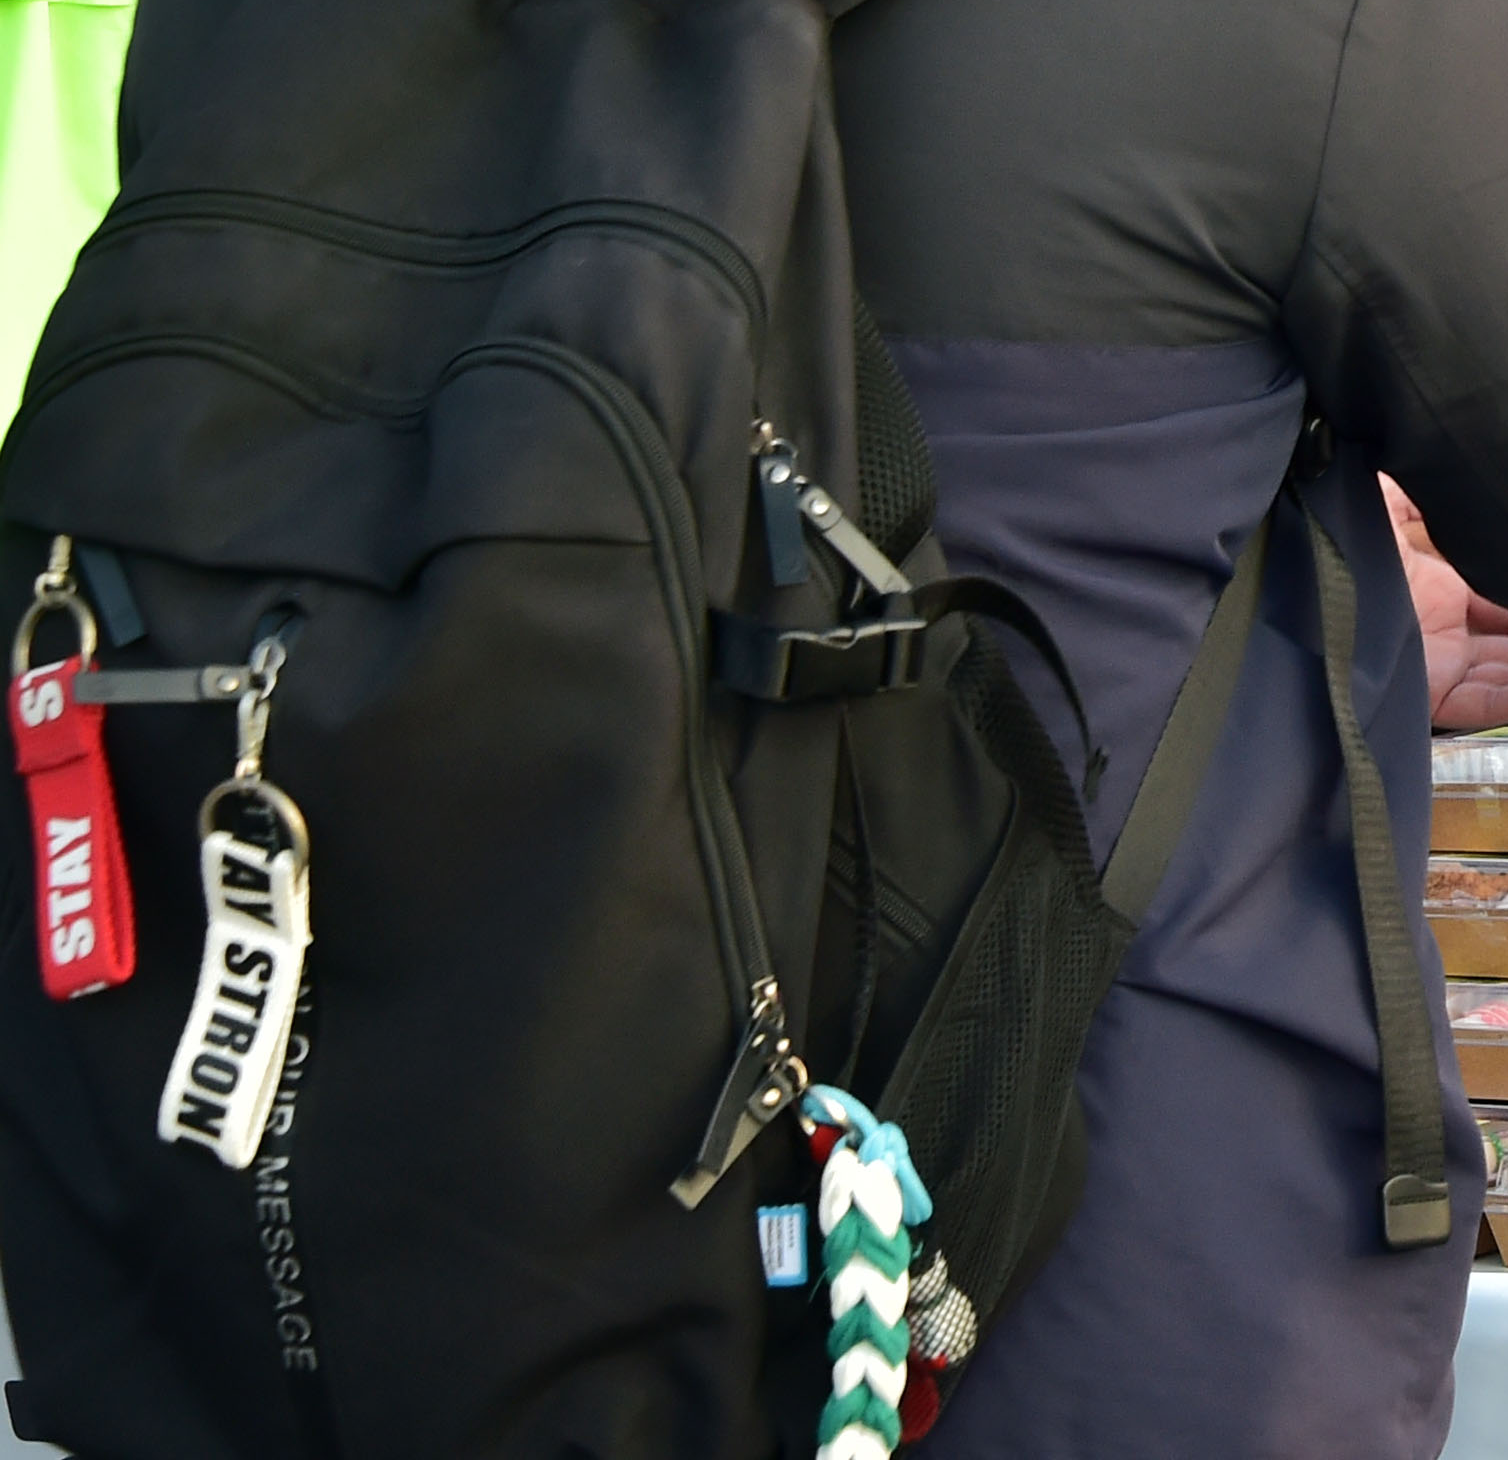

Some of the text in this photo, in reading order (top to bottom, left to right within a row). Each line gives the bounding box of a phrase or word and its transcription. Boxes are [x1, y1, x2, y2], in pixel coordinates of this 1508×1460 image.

[46, 816, 94, 965] STAY
[176, 944, 275, 1141] STRON
[255, 1156, 317, 1373] MESSAGE
